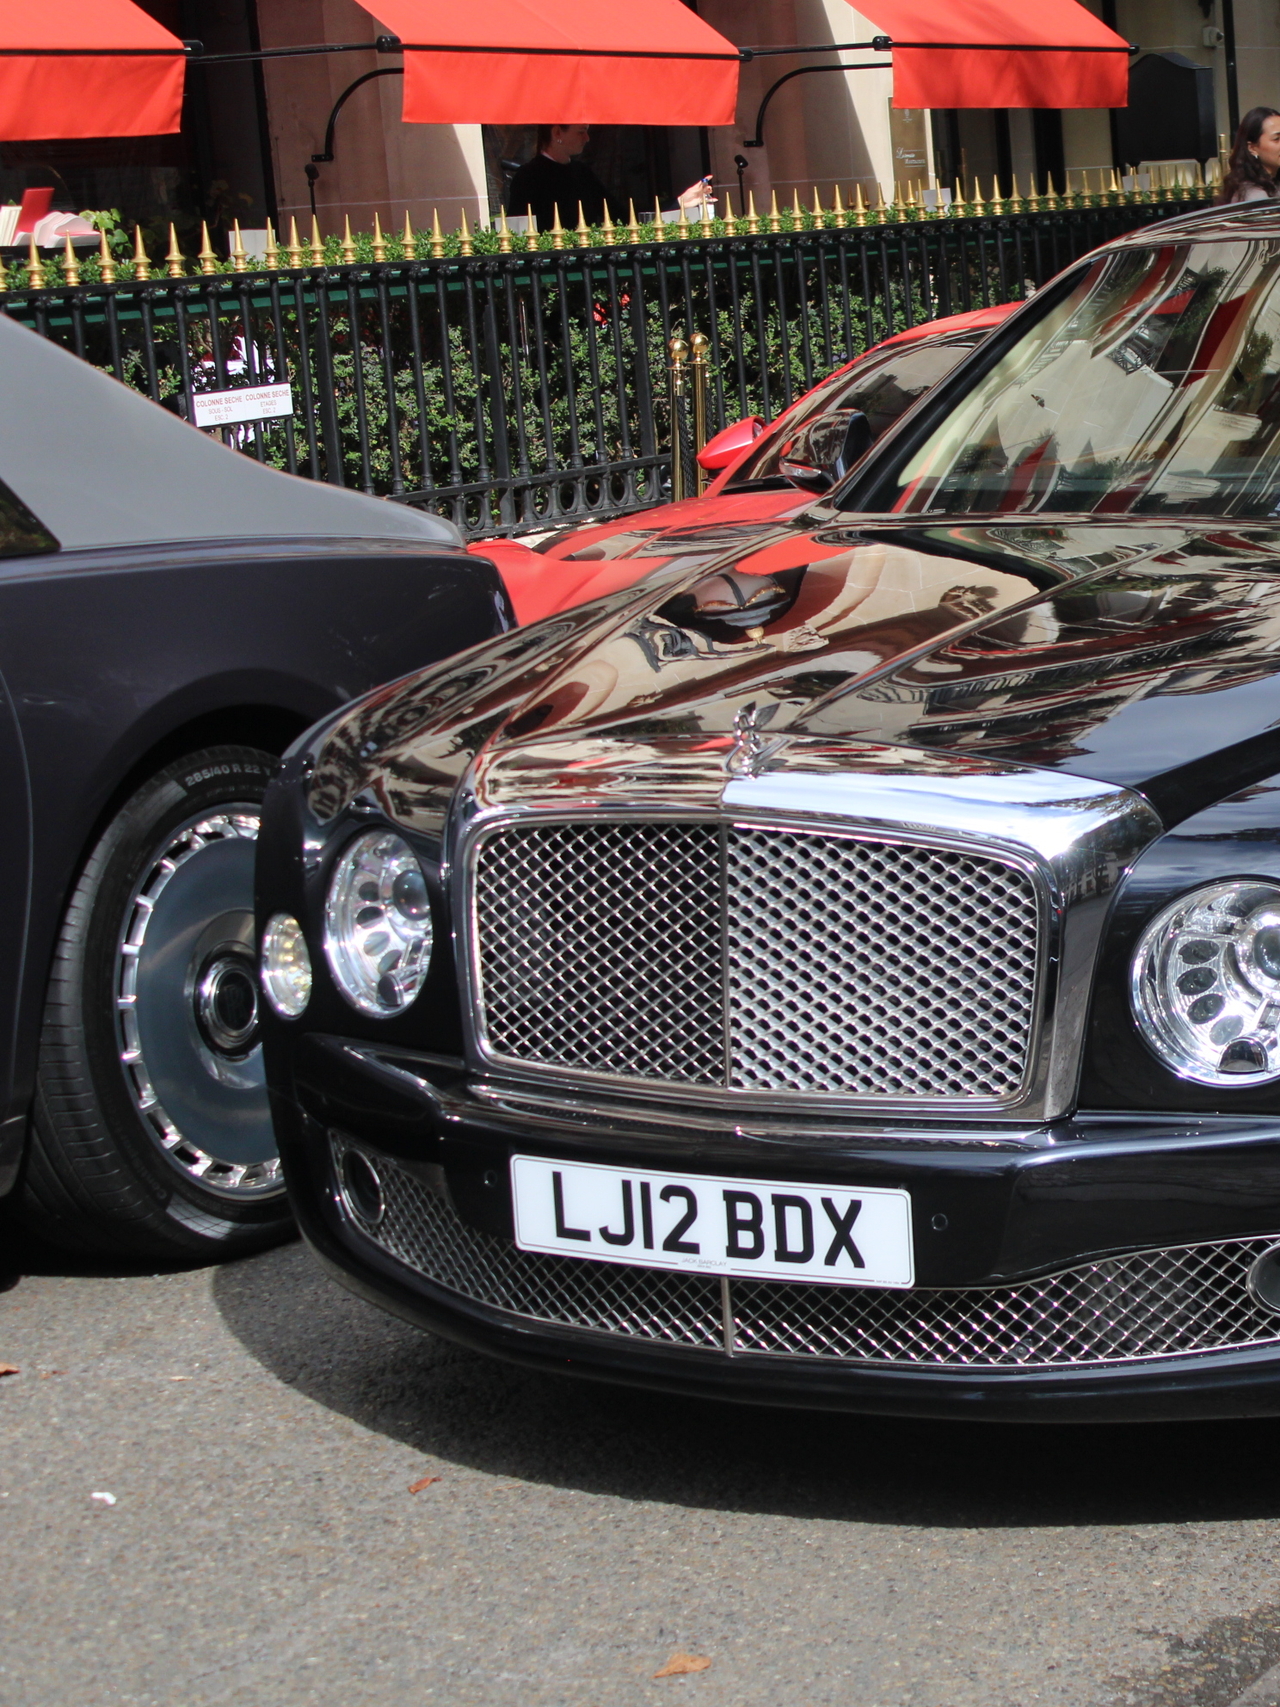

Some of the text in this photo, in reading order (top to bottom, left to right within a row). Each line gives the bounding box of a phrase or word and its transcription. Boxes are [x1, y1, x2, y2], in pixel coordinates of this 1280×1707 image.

[245, 389, 290, 401] COLONNE SECHE
[196, 395, 243, 408] COLONNE SECHE
[260, 400, 277, 408] ETAGES
[184, 764, 230, 787] 285/40
[231, 763, 242, 773] R
[243, 763, 262, 774] 22
[552, 1170, 866, 1269] LJ12 BDX
[698, 1258, 727, 1267] BARCLAY
